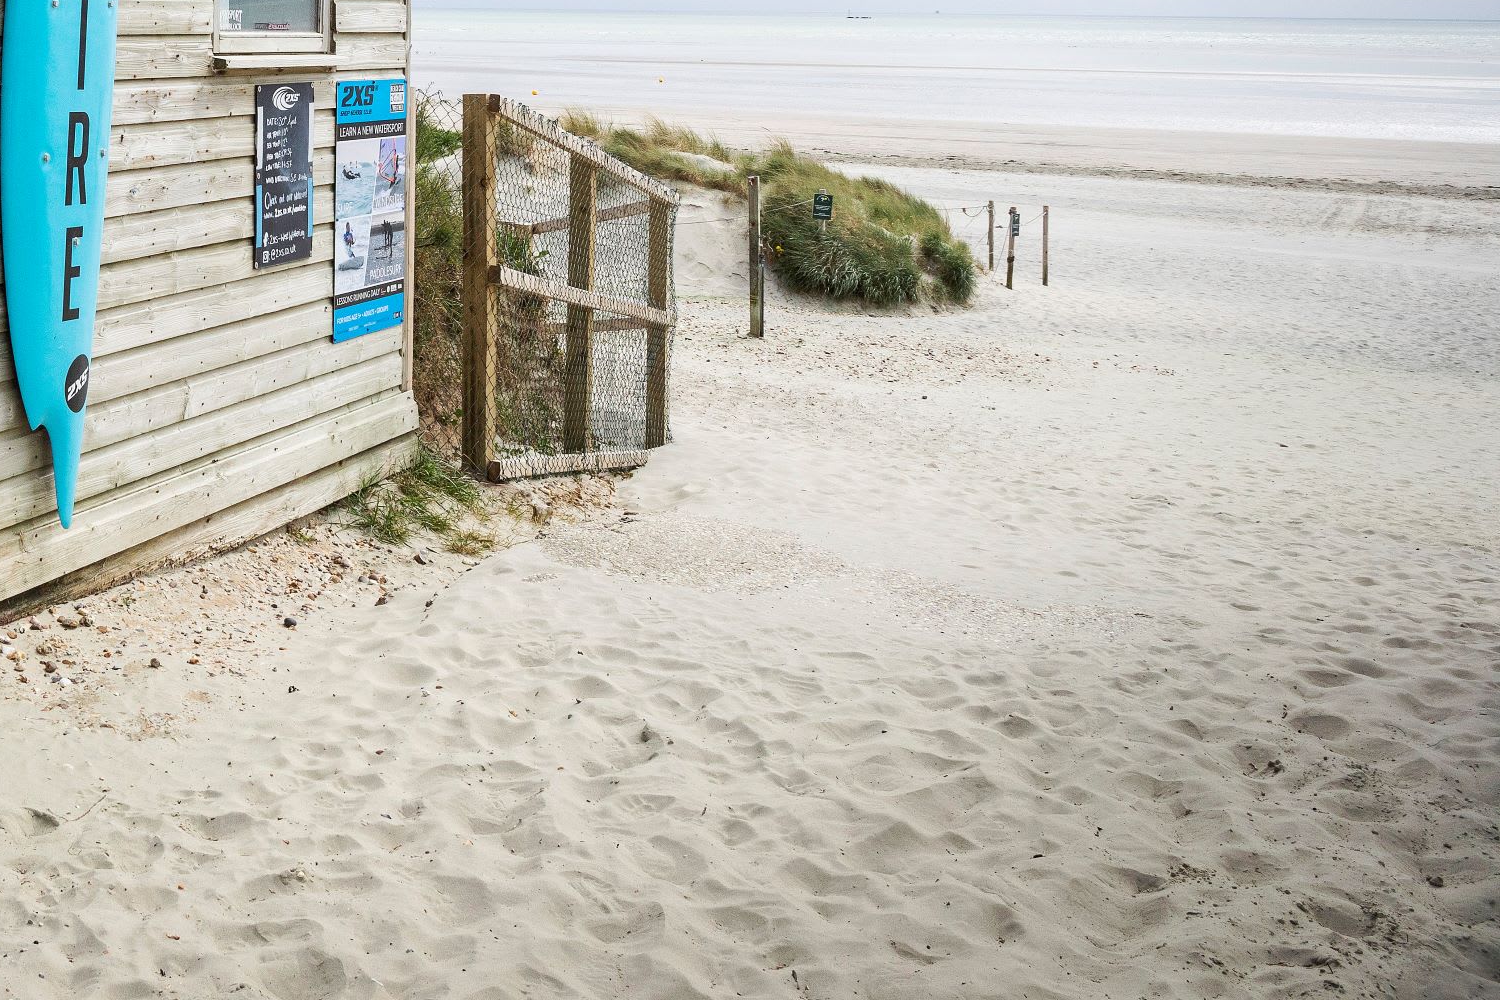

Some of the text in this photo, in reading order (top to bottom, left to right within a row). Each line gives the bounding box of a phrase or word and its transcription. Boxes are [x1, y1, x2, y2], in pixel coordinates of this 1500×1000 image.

[341, 85, 375, 107] 2XS
[340, 127, 356, 138] LEARN
[362, 125, 373, 135] NEW
[374, 122, 404, 135] WATERSPORT
